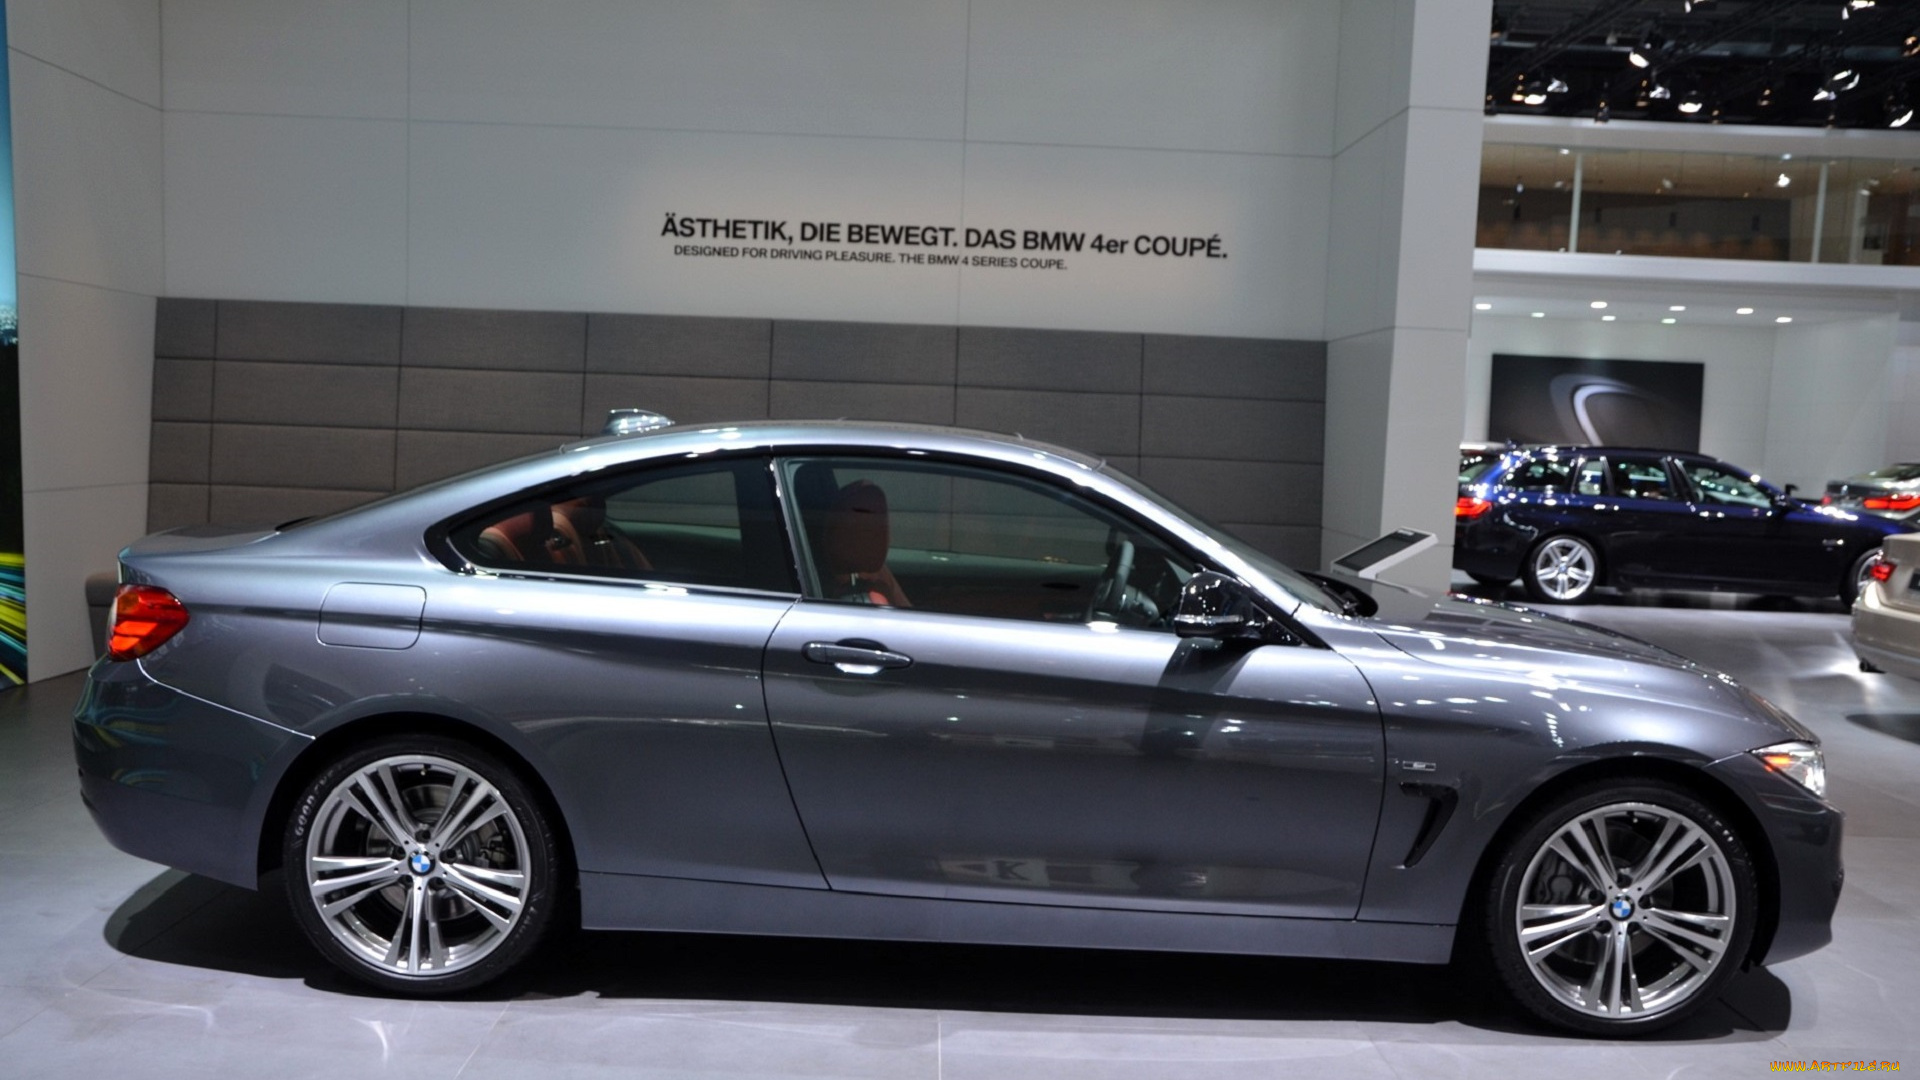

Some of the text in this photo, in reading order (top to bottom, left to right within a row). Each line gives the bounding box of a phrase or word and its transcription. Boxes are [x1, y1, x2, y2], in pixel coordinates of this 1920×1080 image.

[660, 212, 1228, 259] ÄSTHETIK, DIE BEWEGT. DAS BMW 4er COUPÉ.
[673, 245, 1068, 270] DESIGNED FOR DRIVING PLEASURE. THE BMW 4 SERIES COUPE.
